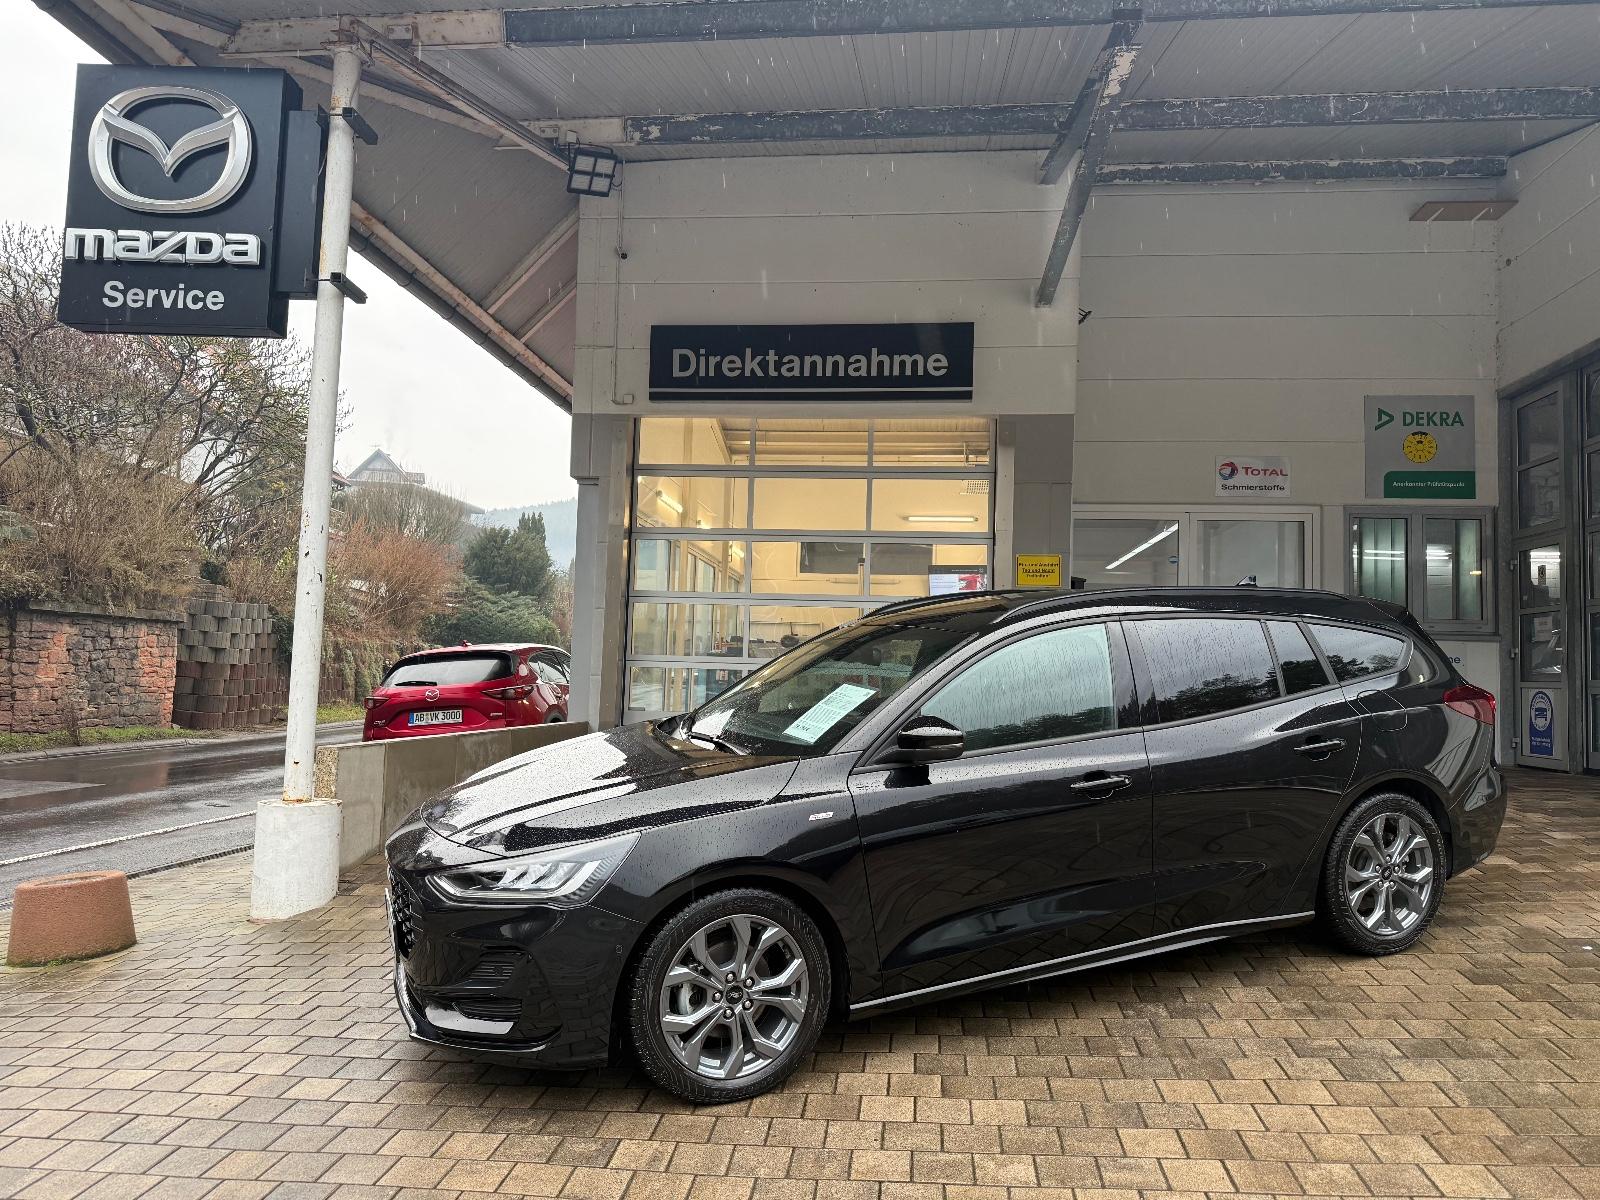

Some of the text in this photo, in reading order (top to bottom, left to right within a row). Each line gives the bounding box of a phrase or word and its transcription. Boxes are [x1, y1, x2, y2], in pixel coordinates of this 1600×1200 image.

[102, 280, 225, 311] Service
[671, 347, 949, 378] Direktannahme
[1402, 411, 1465, 427] DEKRA
[1221, 483, 1285, 491] Schmierstoffe
[414, 710, 461, 723] AB VK 3000
